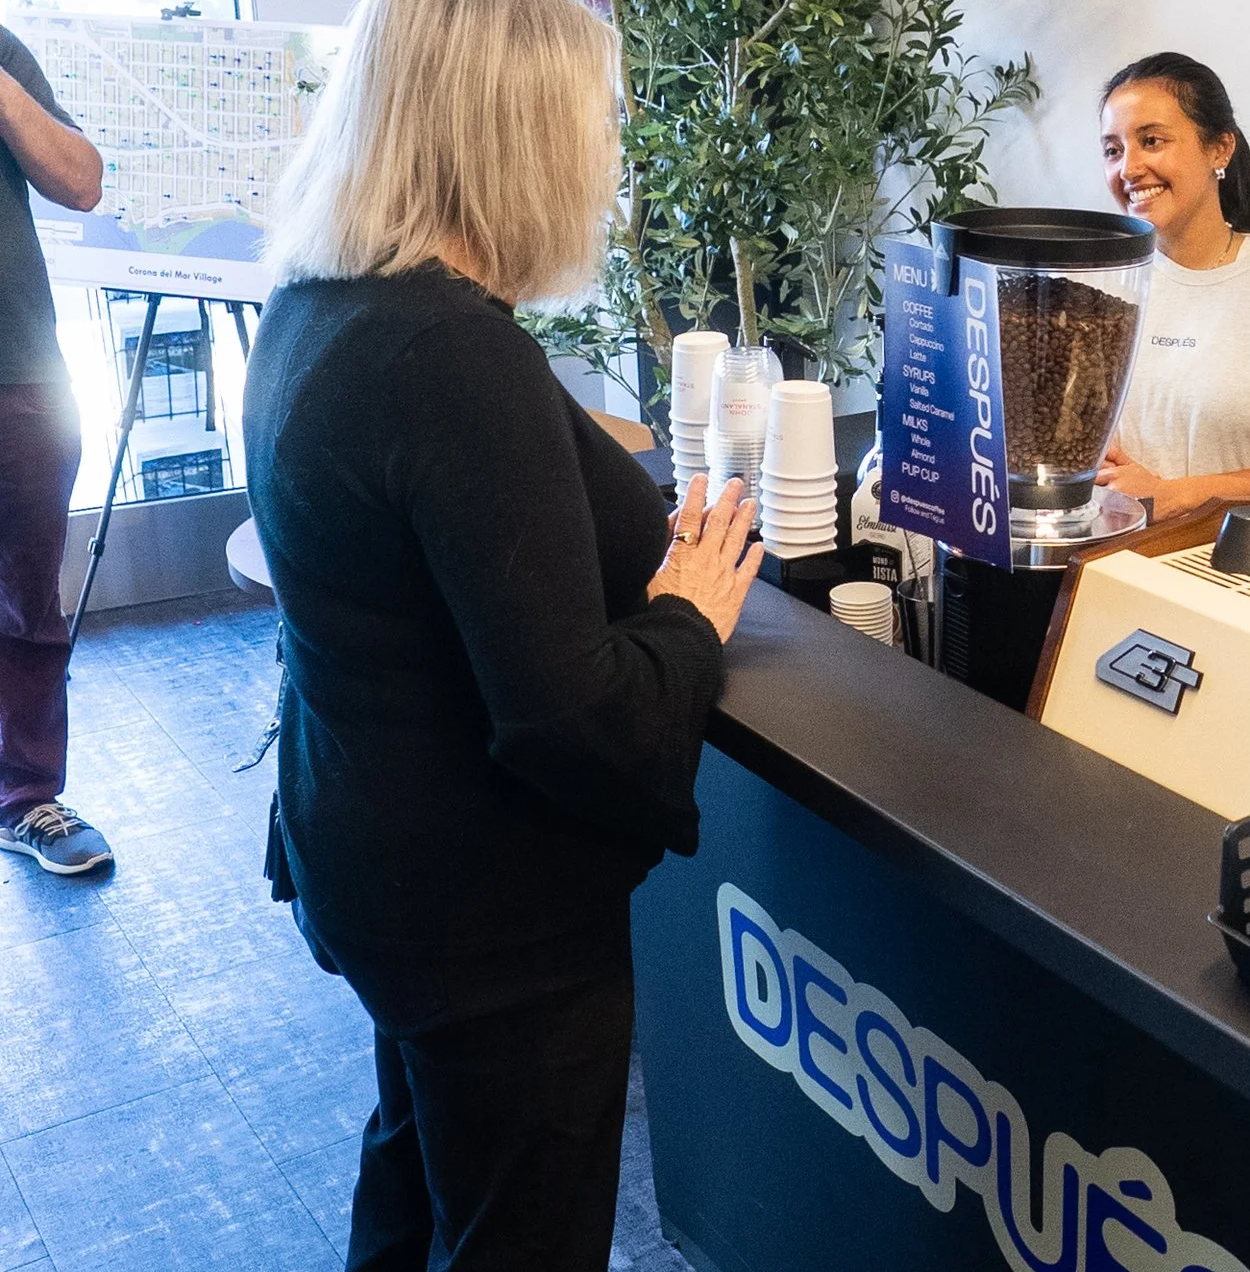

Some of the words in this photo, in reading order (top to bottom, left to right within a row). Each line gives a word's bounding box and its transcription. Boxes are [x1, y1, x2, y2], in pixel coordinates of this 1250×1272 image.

[128, 266, 157, 277] Corona
[160, 270, 172, 278] del
[174, 271, 190, 280] Mar
[193, 272, 222, 284] Village
[893, 264, 928, 288] MENU
[902, 300, 934, 320] COFFEE
[908, 317, 935, 333] Cortado
[909, 334, 945, 352] Cappuccino
[909, 349, 928, 363] Latte
[902, 364, 936, 385] SYRUPS
[909, 382, 930, 398] Vanilla
[909, 398, 931, 413] Salted
[930, 404, 956, 422] Caramel
[965, 278, 1000, 535] DESPUÉS
[902, 413, 929, 432] MILKS
[911, 432, 932, 448] Whole
[911, 448, 936, 465] Almond
[901, 461, 920, 478] PUP
[920, 468, 940, 483] CUP
